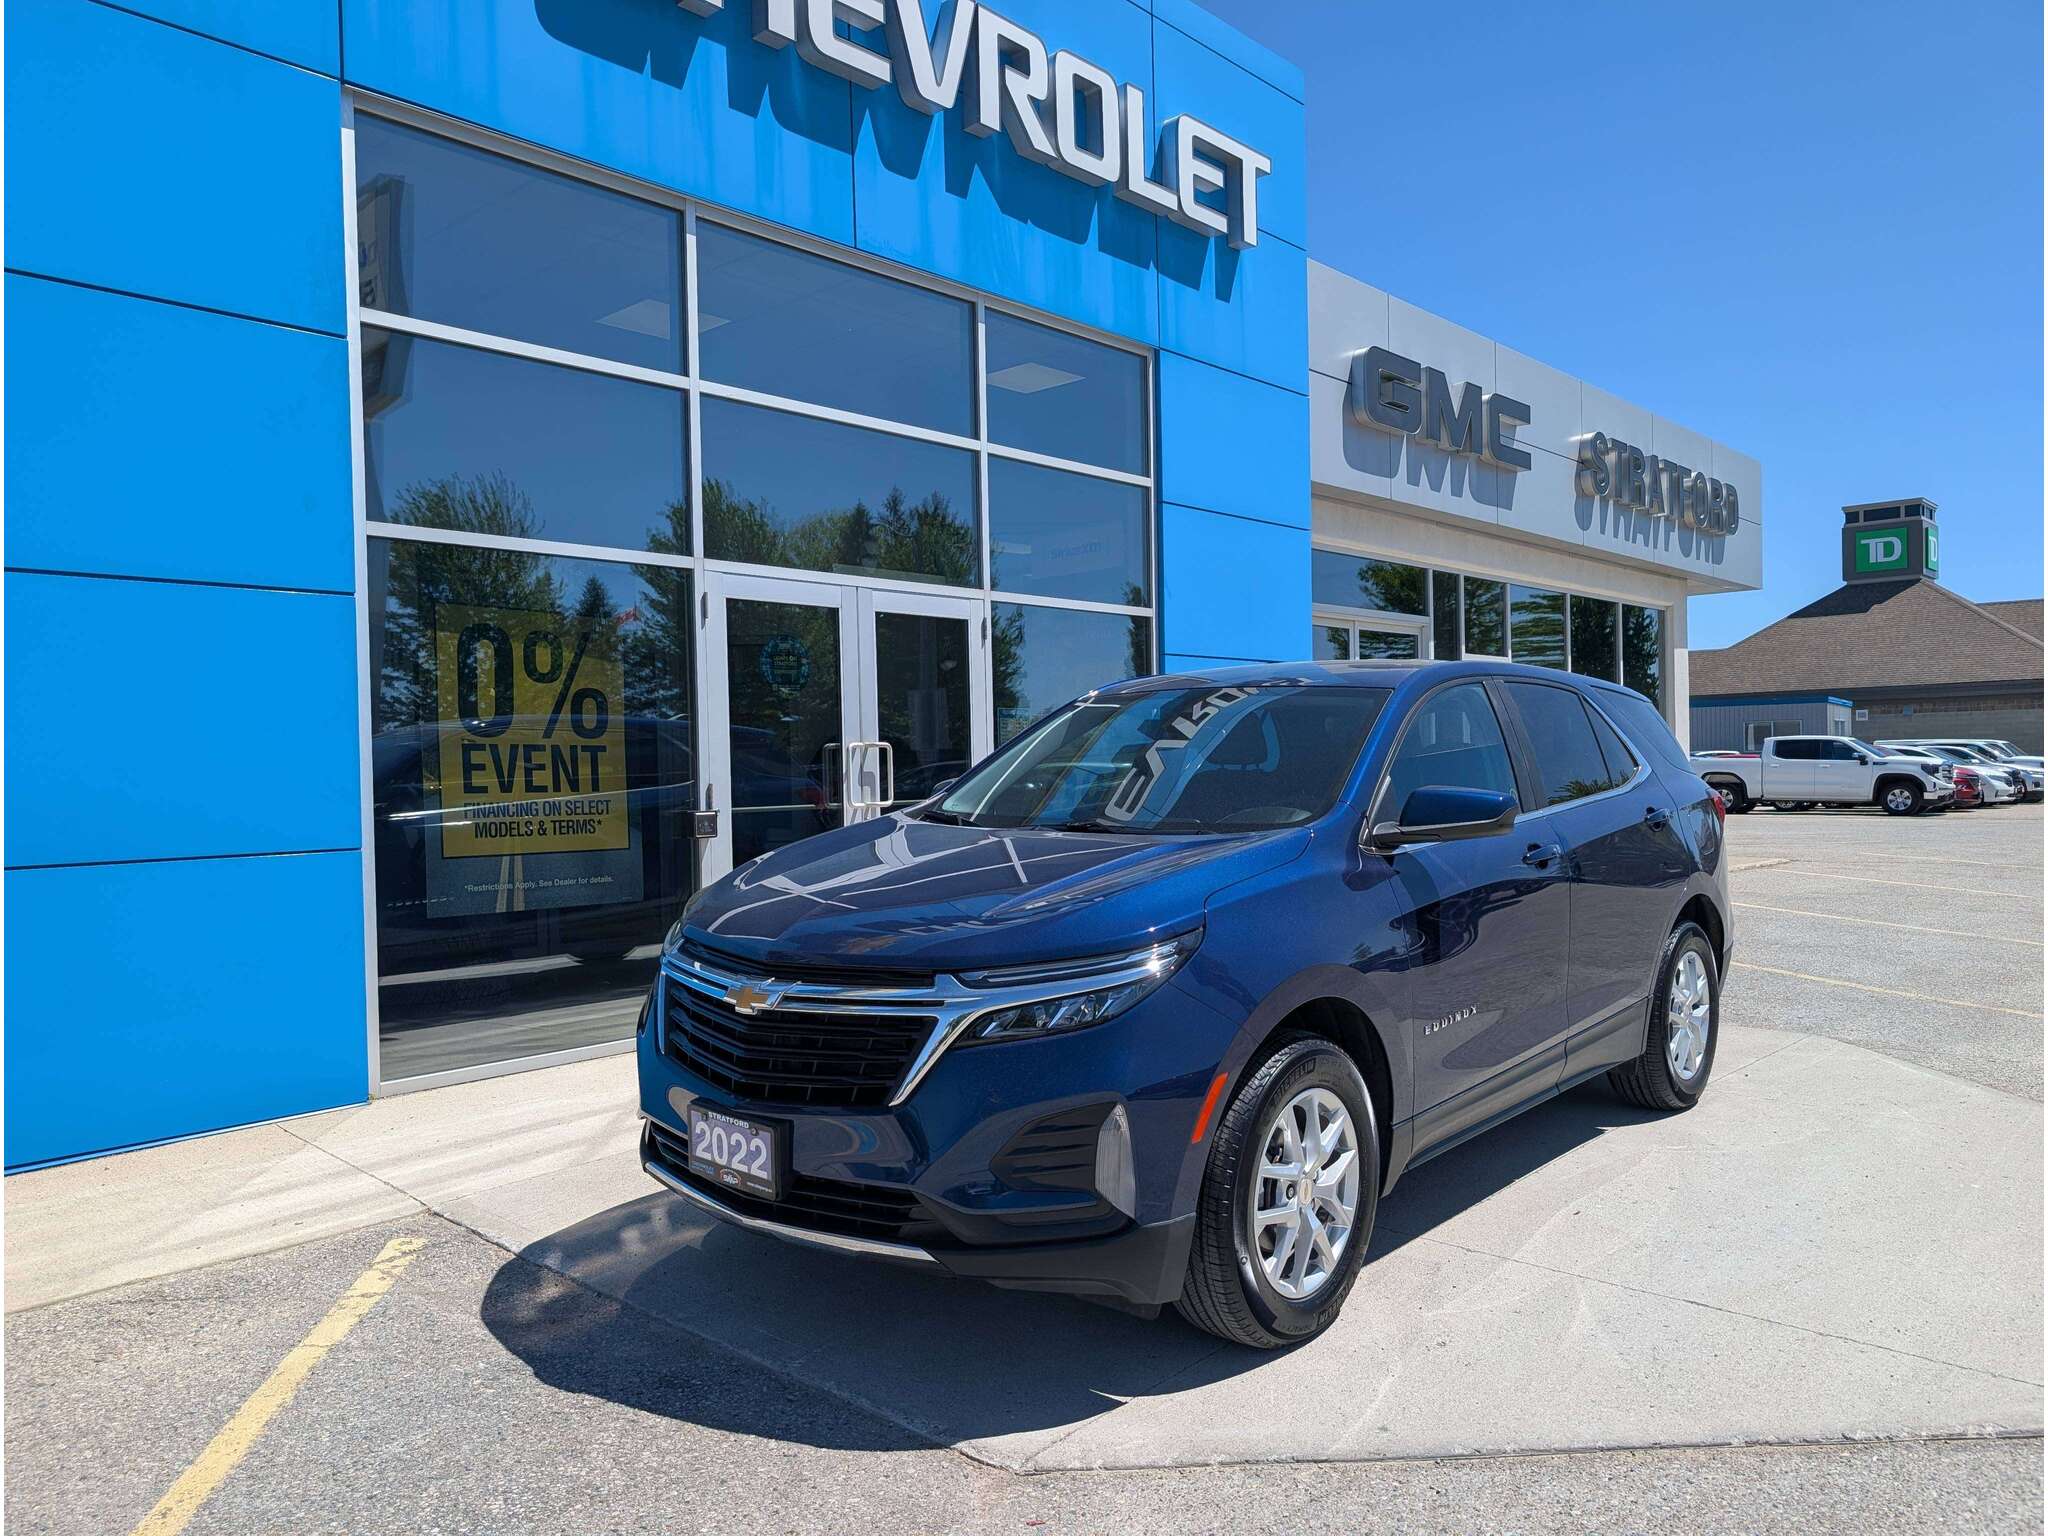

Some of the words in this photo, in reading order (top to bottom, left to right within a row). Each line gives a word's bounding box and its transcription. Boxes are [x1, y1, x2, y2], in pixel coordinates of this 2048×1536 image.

[1351, 345, 1532, 472] GMC
[1579, 431, 1739, 537] STRATFORD
[1860, 536, 1902, 563] TD
[457, 622, 609, 739] 0%
[461, 743, 607, 794] EVENT
[463, 801, 539, 819] FINANCING
[543, 800, 562, 817] ON
[565, 799, 612, 816] SELECT
[474, 820, 533, 839] MODELS
[538, 820, 548, 836] &
[539, 879, 552, 888] See
[554, 877, 577, 887] Dealer
[578, 876, 588, 885] for
[708, 1111, 749, 1129] STRATFORD
[695, 1121, 768, 1179] 2022
